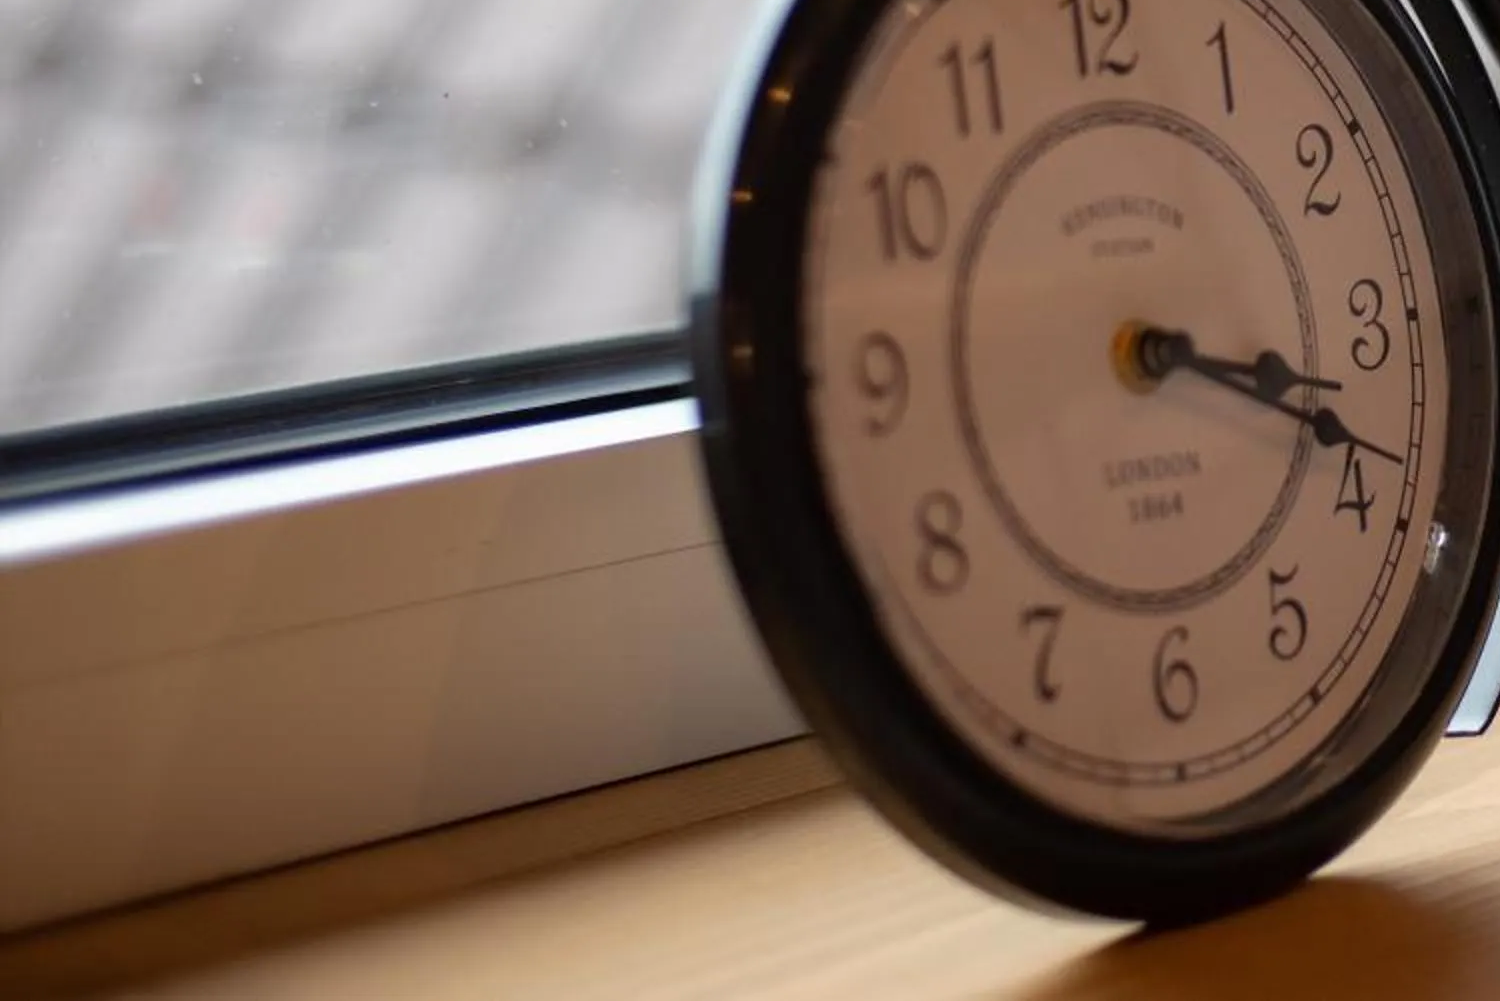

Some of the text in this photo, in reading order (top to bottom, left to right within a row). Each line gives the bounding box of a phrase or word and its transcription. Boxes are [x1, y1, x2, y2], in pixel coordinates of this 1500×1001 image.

[938, 35, 1005, 137] 11
[1205, 20, 1234, 115] 1
[866, 162, 948, 262] 10
[1295, 123, 1341, 217] 2
[1348, 279, 1390, 371] 3
[858, 330, 910, 438] 9
[1102, 449, 1201, 489] LONDON
[1333, 443, 1375, 533] 4
[914, 489, 970, 595] 8
[1020, 606, 1066, 704] 7
[1268, 563, 1308, 661] 5
[1152, 626, 1199, 723] 6
